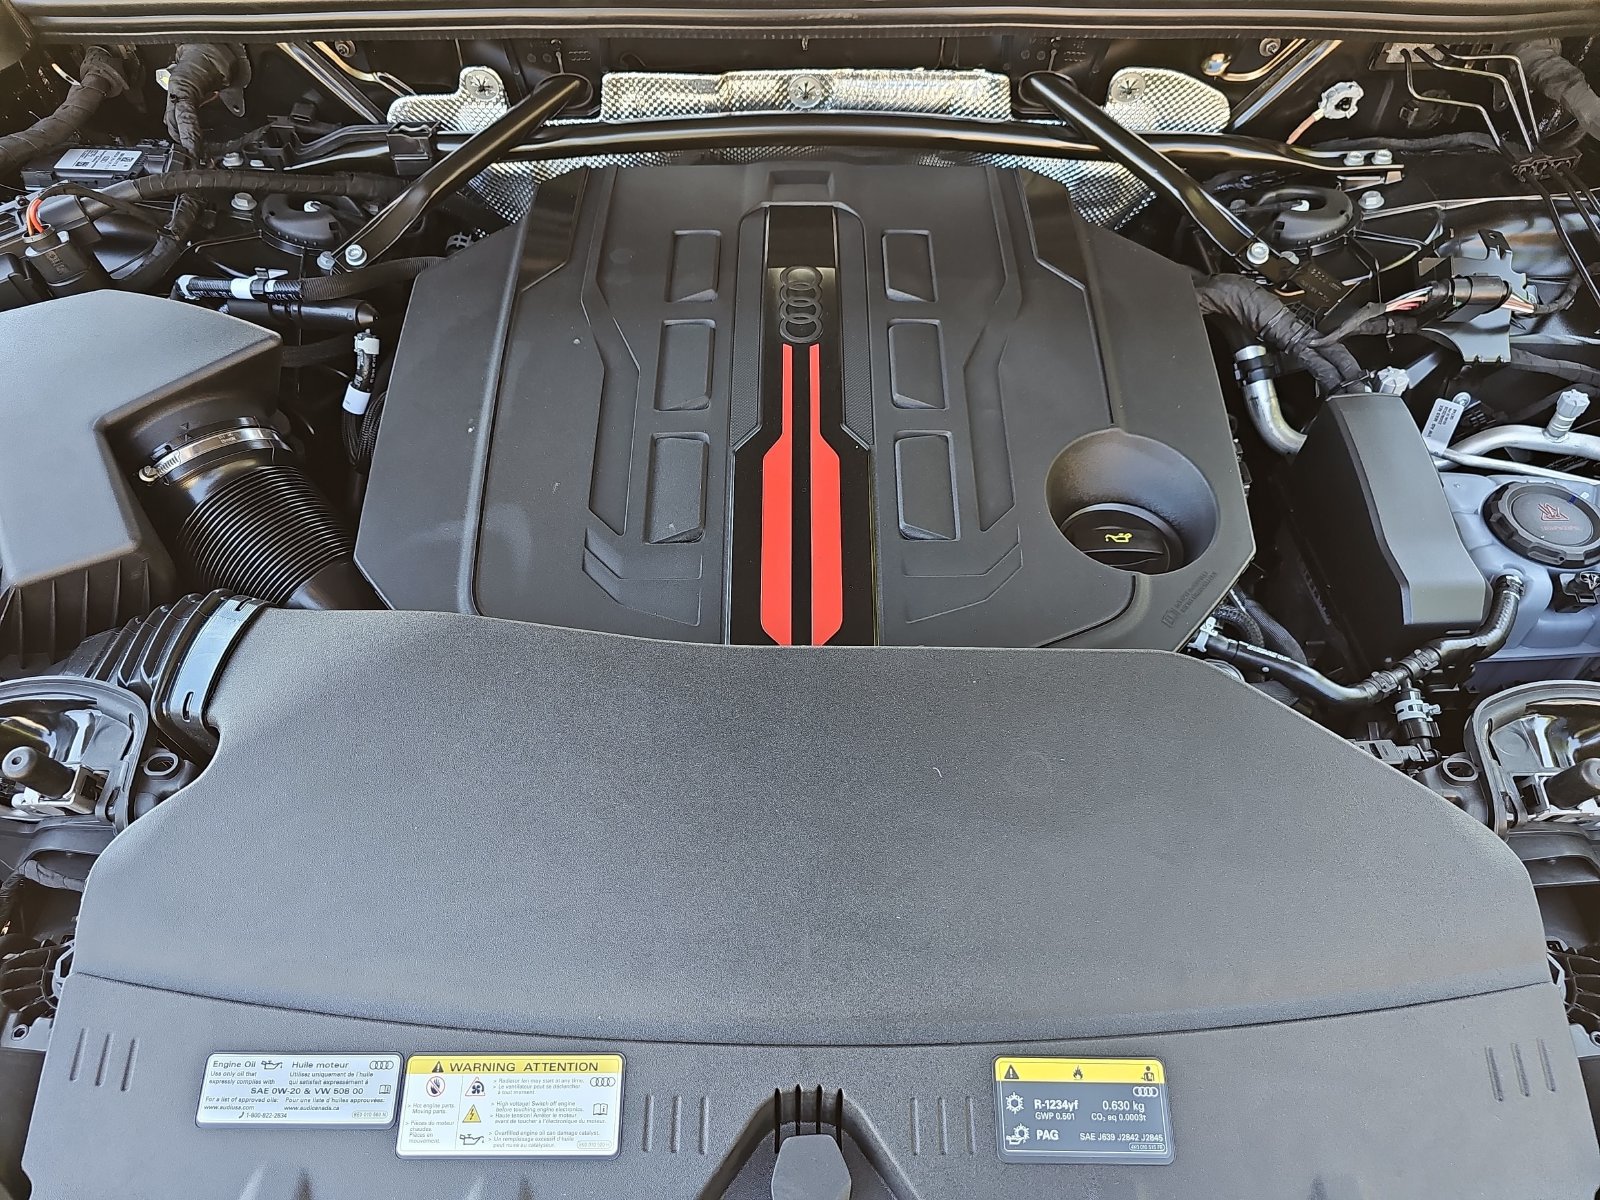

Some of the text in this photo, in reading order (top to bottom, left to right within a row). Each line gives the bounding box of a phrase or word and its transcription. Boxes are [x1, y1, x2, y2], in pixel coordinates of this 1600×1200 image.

[212, 1060, 242, 1069] Engine
[450, 1062, 598, 1072] WARNING ATTENTION
[1034, 1099, 1079, 1112] R-1234yf
[1102, 1100, 1145, 1113] 0.630 kg
[1035, 1112, 1054, 1120] GWP
[1107, 1115, 1117, 1123] eq
[1036, 1130, 1059, 1140] PAG
[1141, 1134, 1164, 1142] J2845
